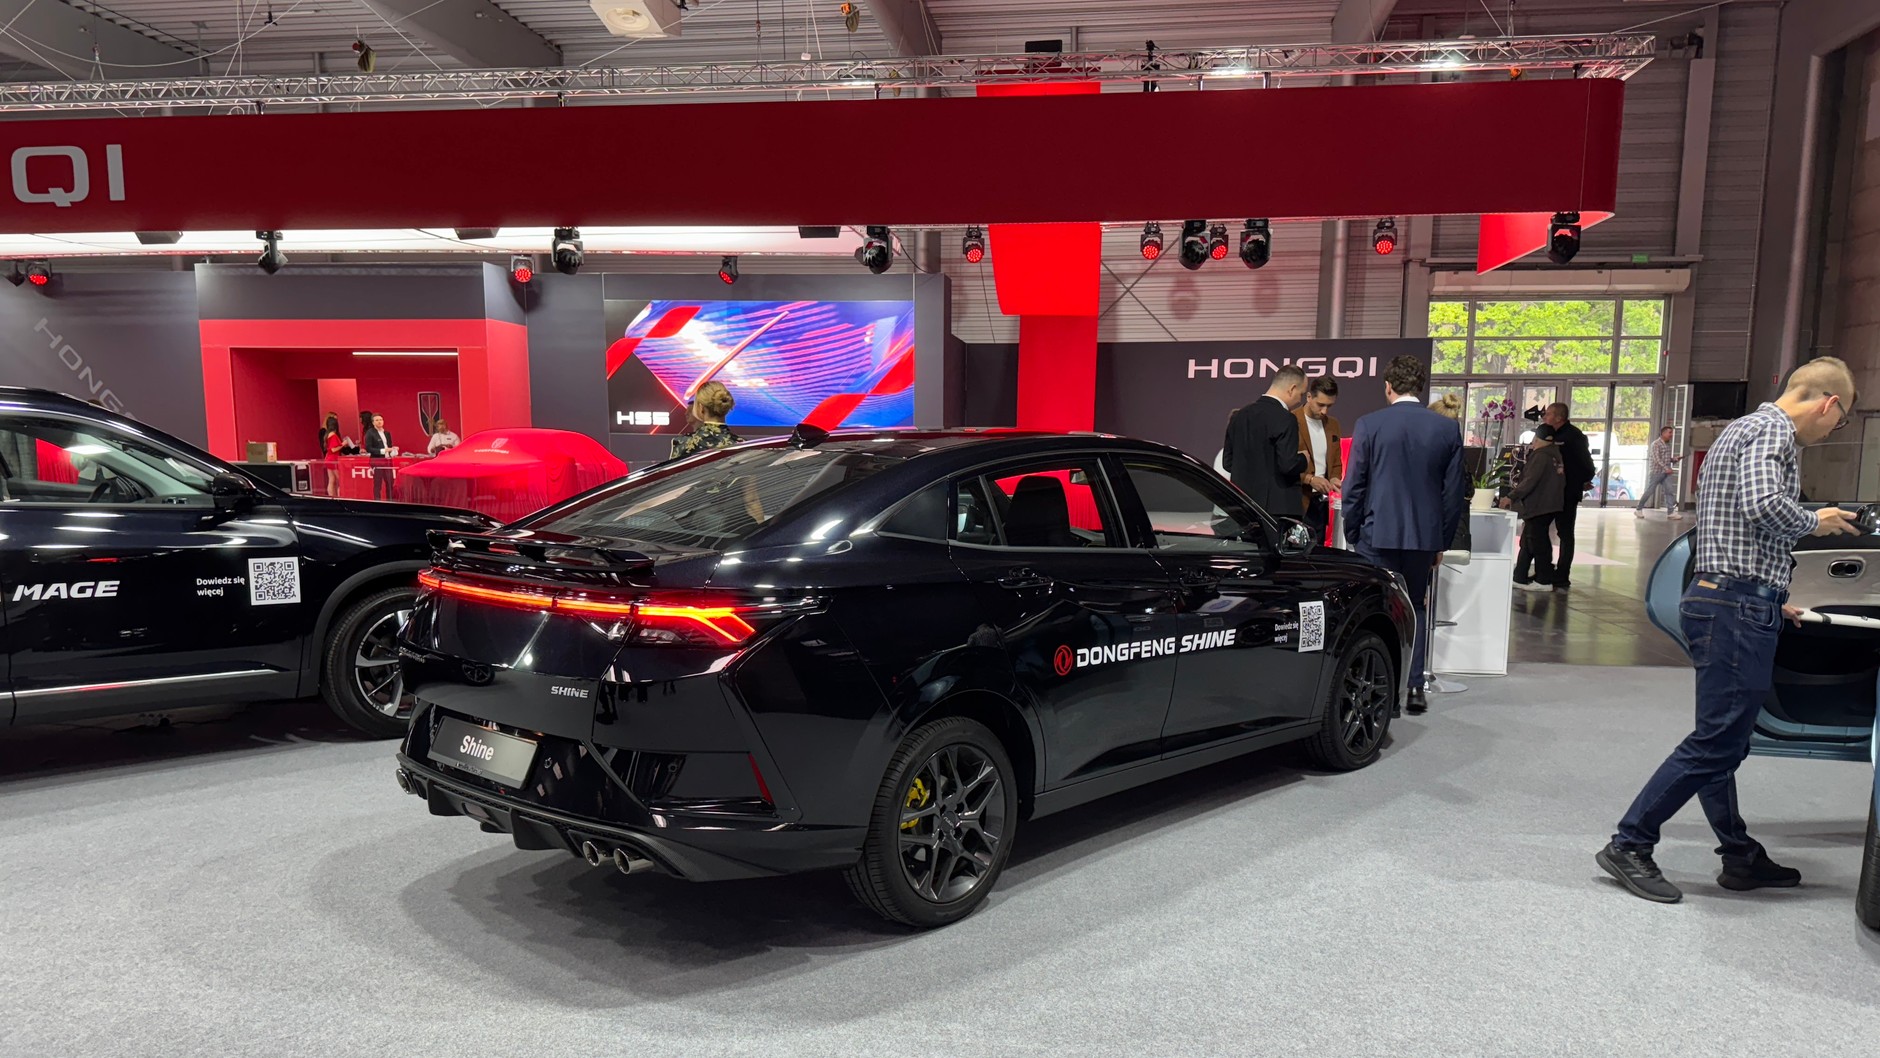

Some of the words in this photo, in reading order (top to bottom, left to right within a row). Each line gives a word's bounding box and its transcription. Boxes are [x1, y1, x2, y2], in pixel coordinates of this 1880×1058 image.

[10, 143, 126, 208] QI
[33, 317, 138, 421] HONG
[1187, 356, 1378, 379] HONGQI
[12, 580, 121, 602] MAGE
[196, 576, 232, 586] Dowiedz
[233, 575, 246, 586] się
[196, 586, 224, 598] więcej
[1076, 637, 1176, 668] DONGFENG
[1179, 628, 1237, 653] SHINE
[550, 685, 589, 699] SHINE
[459, 735, 495, 761] Shine
